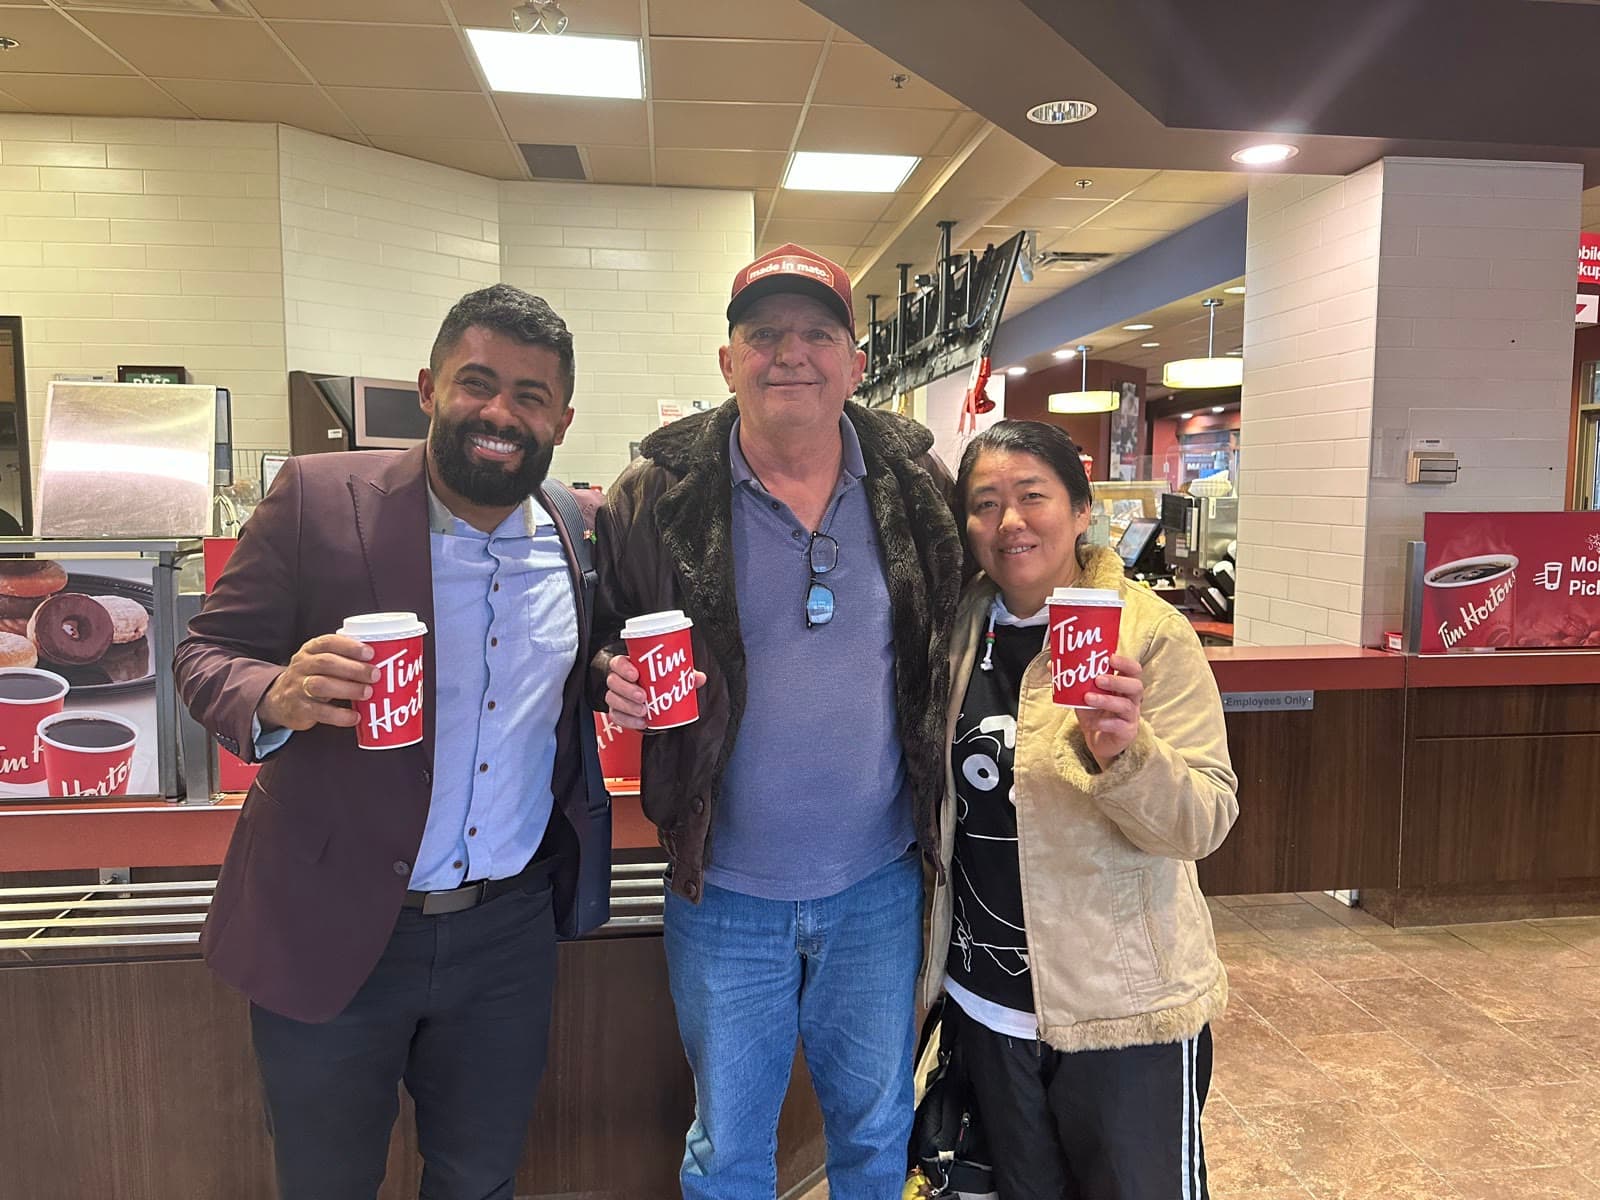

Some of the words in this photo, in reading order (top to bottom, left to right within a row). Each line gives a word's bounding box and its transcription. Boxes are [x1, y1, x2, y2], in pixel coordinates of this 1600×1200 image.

[749, 263, 780, 279] made
[782, 260, 794, 271] in
[1438, 621, 1467, 649] Tim
[1460, 571, 1516, 631] Hortons
[1052, 615, 1103, 655] Tim
[638, 643, 687, 682] Tim
[1226, 696, 1281, 708] Employees
[1284, 695, 1307, 706] Only
